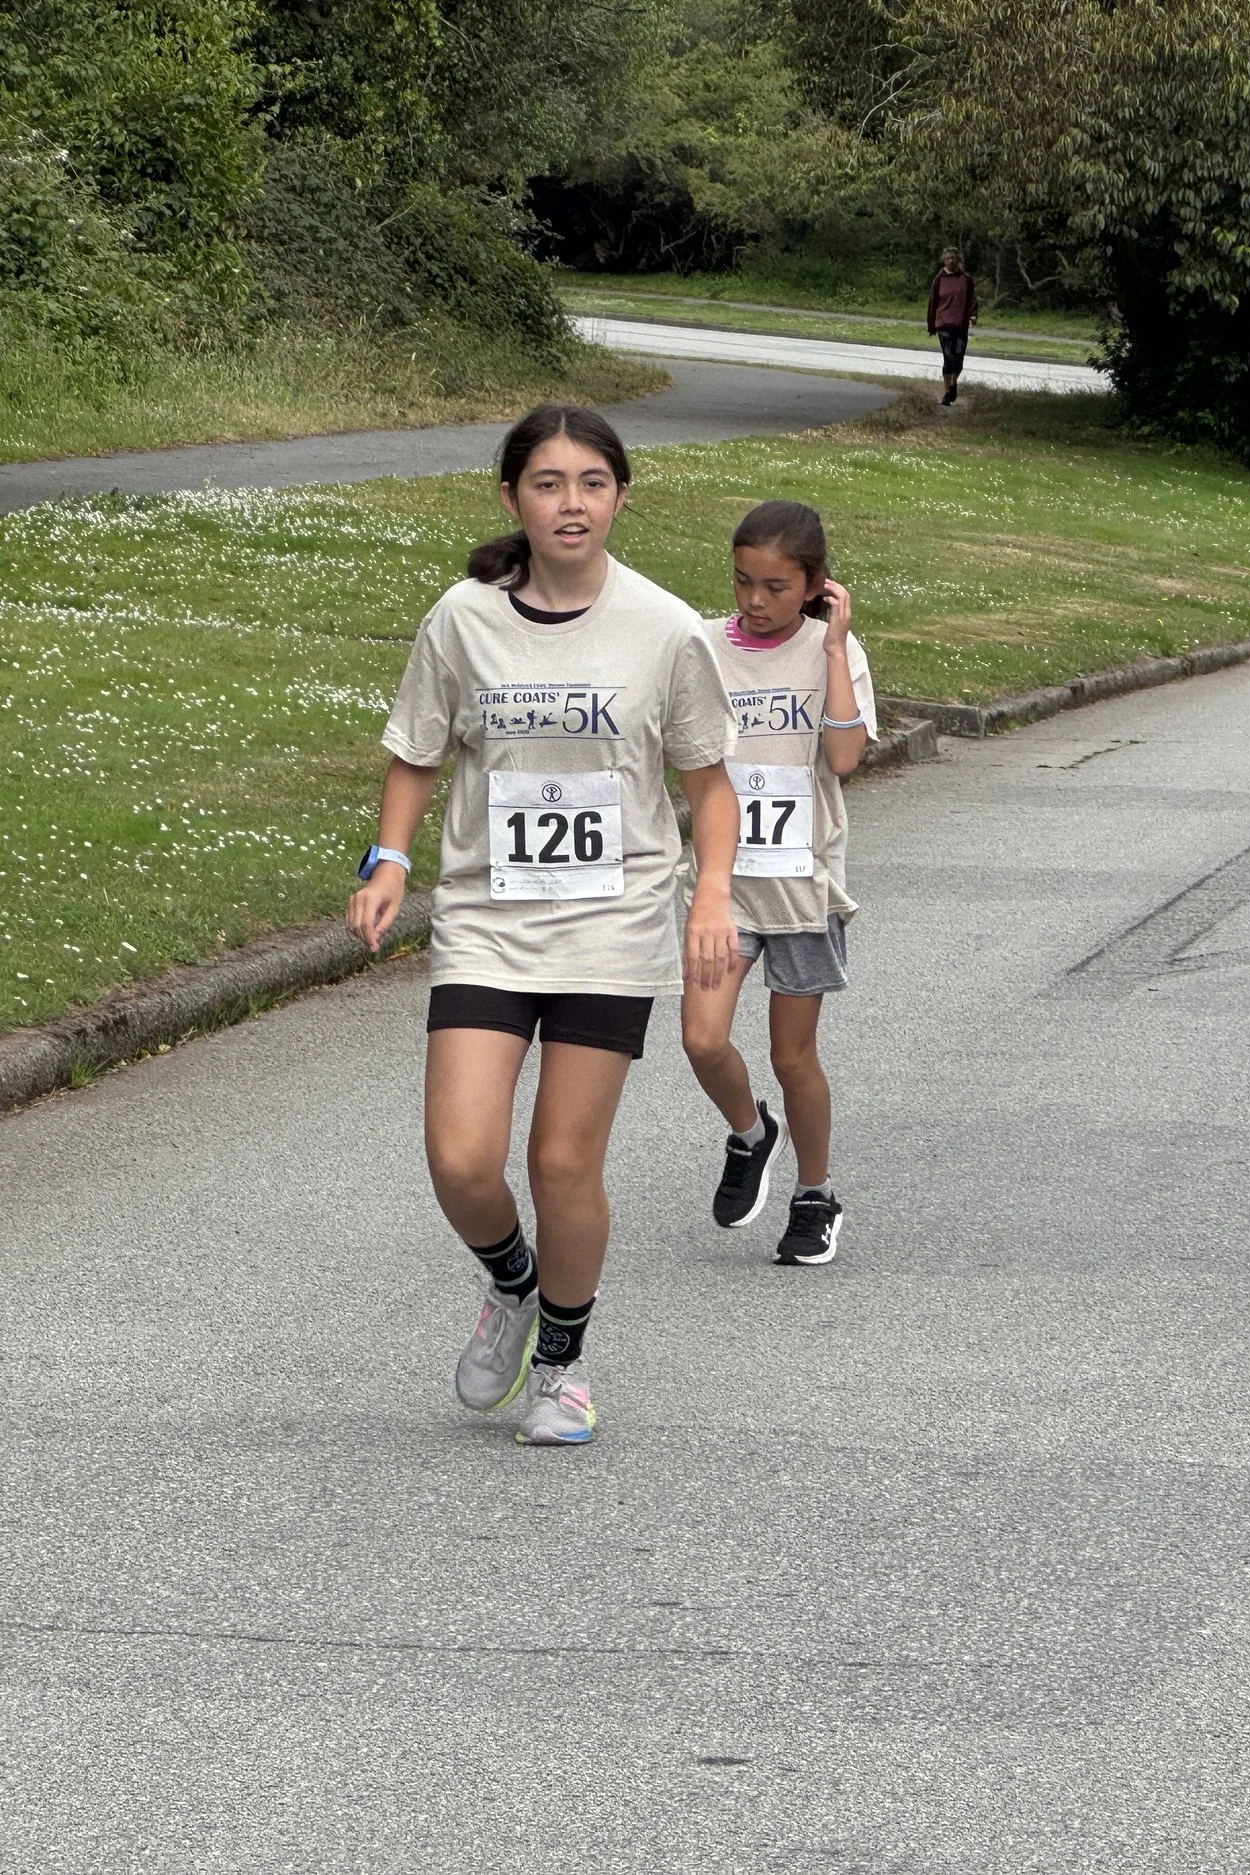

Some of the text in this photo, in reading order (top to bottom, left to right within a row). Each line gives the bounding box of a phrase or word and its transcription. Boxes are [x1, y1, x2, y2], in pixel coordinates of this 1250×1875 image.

[479, 692, 509, 705] CURE
[562, 692, 620, 735] 5K
[768, 693, 814, 731] 5K
[507, 810, 603, 864] 126
[738, 800, 796, 845] 17
